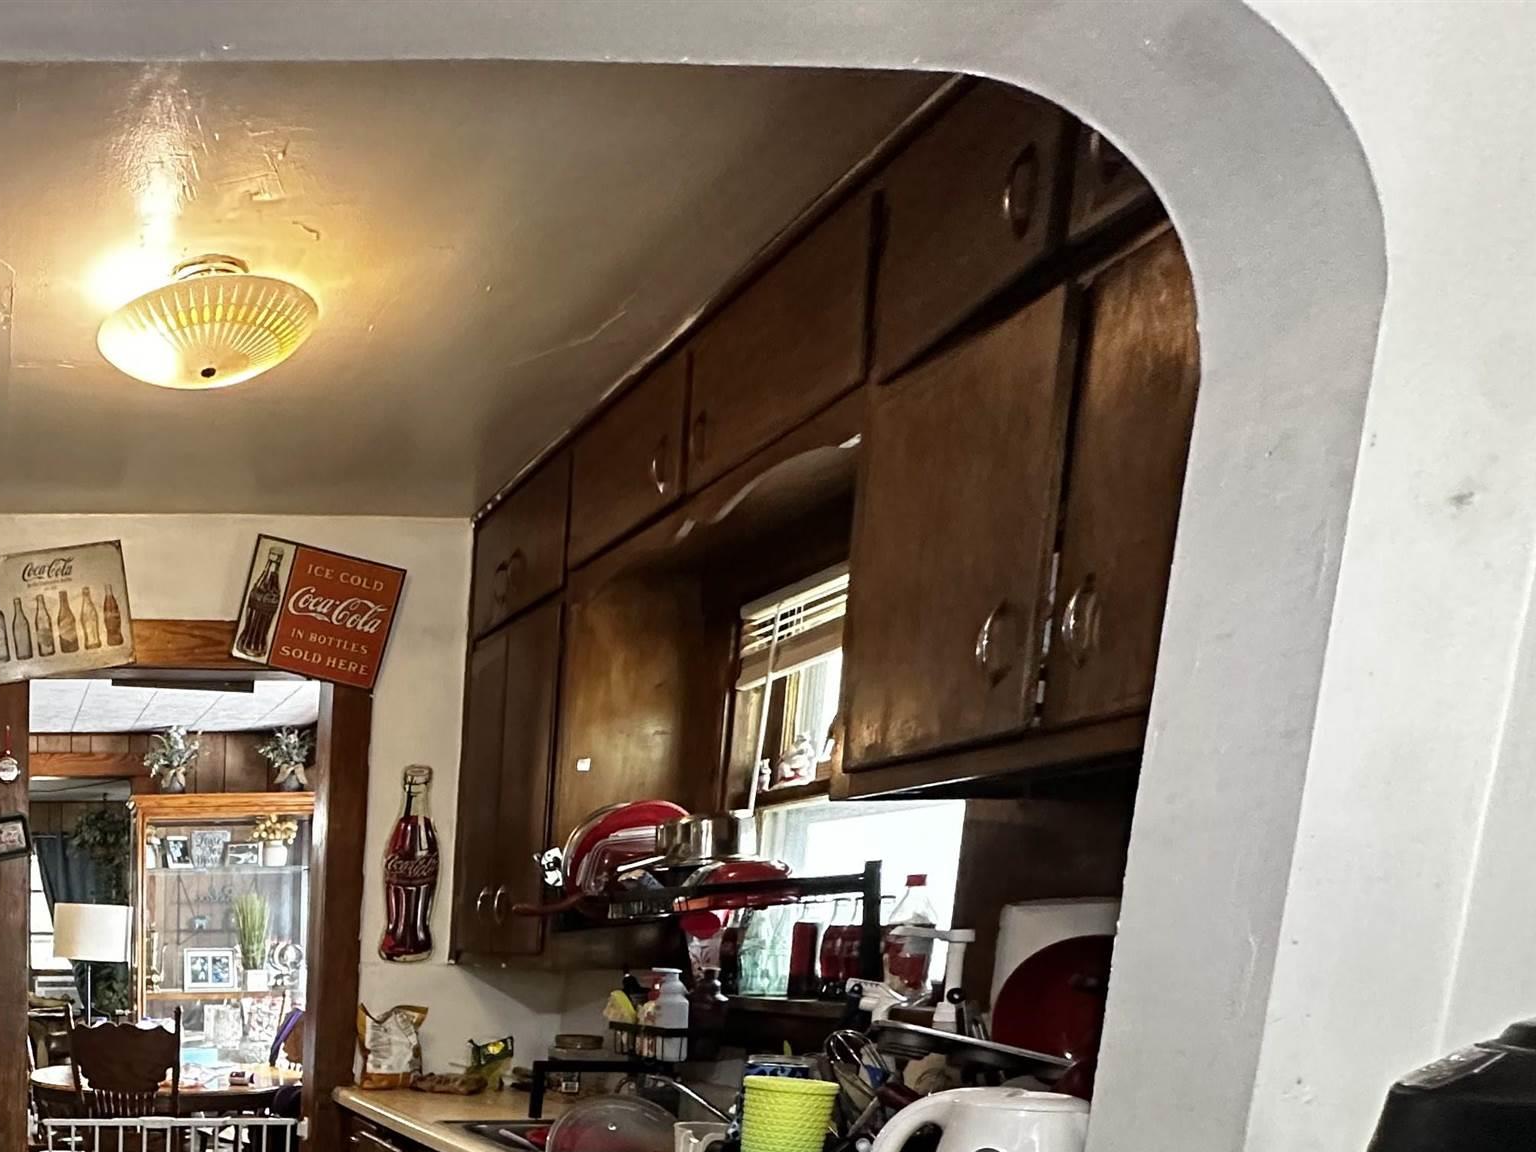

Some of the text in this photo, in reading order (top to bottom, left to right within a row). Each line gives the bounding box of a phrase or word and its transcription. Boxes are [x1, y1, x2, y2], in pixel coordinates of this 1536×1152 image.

[22, 556, 74, 582] Coca-Cola
[307, 564, 384, 592] ICE COLD
[288, 586, 388, 634] Coca-Cola
[291, 627, 368, 655] IN BOTTLES
[279, 645, 369, 676] SOLD HERE
